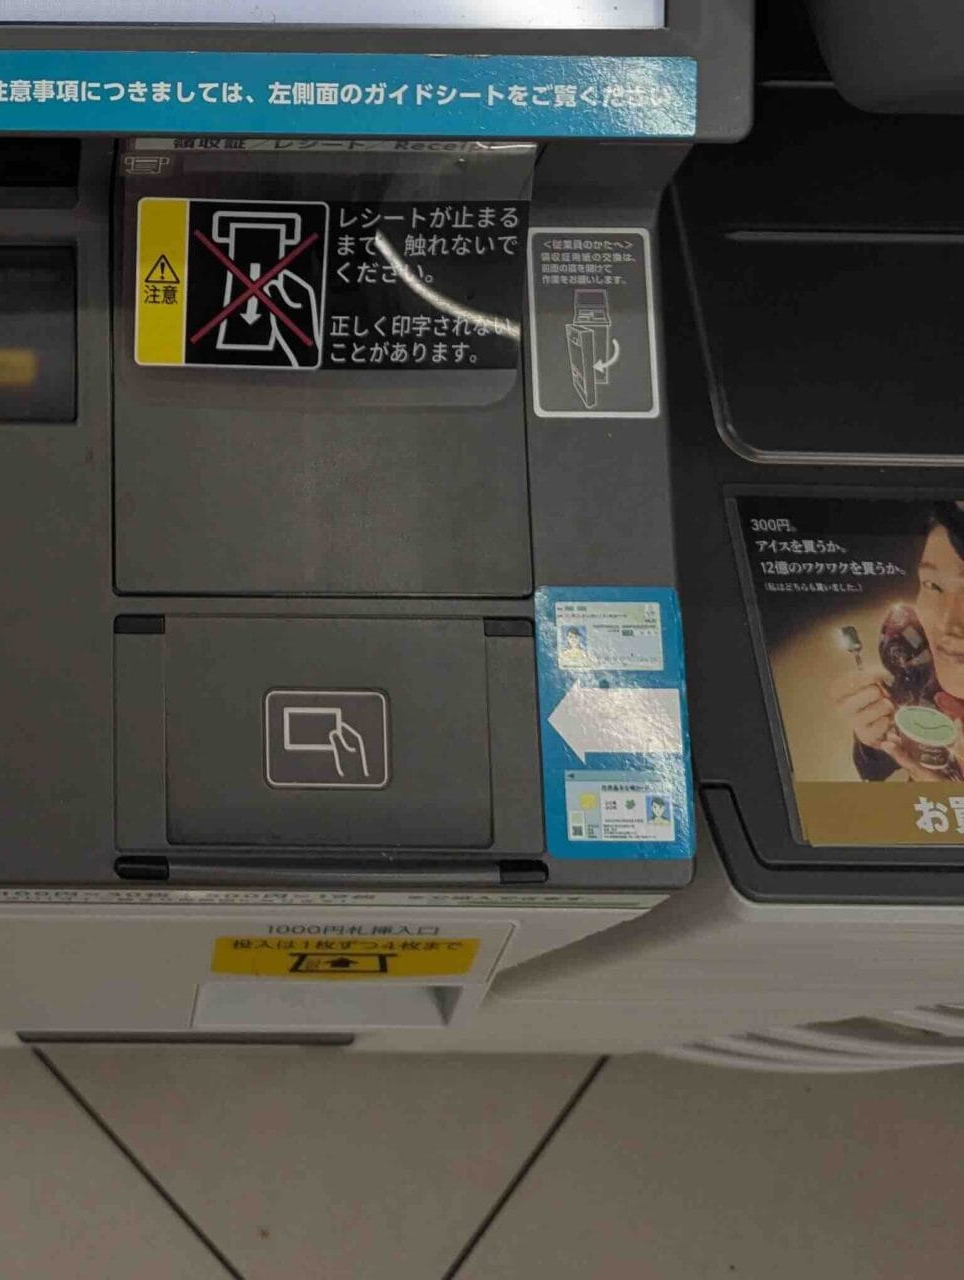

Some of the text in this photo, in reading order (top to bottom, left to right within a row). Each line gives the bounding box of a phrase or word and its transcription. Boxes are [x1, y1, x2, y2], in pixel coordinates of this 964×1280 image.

[339, 206, 519, 229] レシートが止まる
[143, 285, 179, 305] 注意
[329, 315, 511, 337] 正しく印字されない
[330, 342, 478, 364] ことがあります。
[750, 518, 797, 533] 300円。
[754, 539, 848, 554] アイスを買うか。
[759, 560, 907, 576] 12億のワクワクを買うか。
